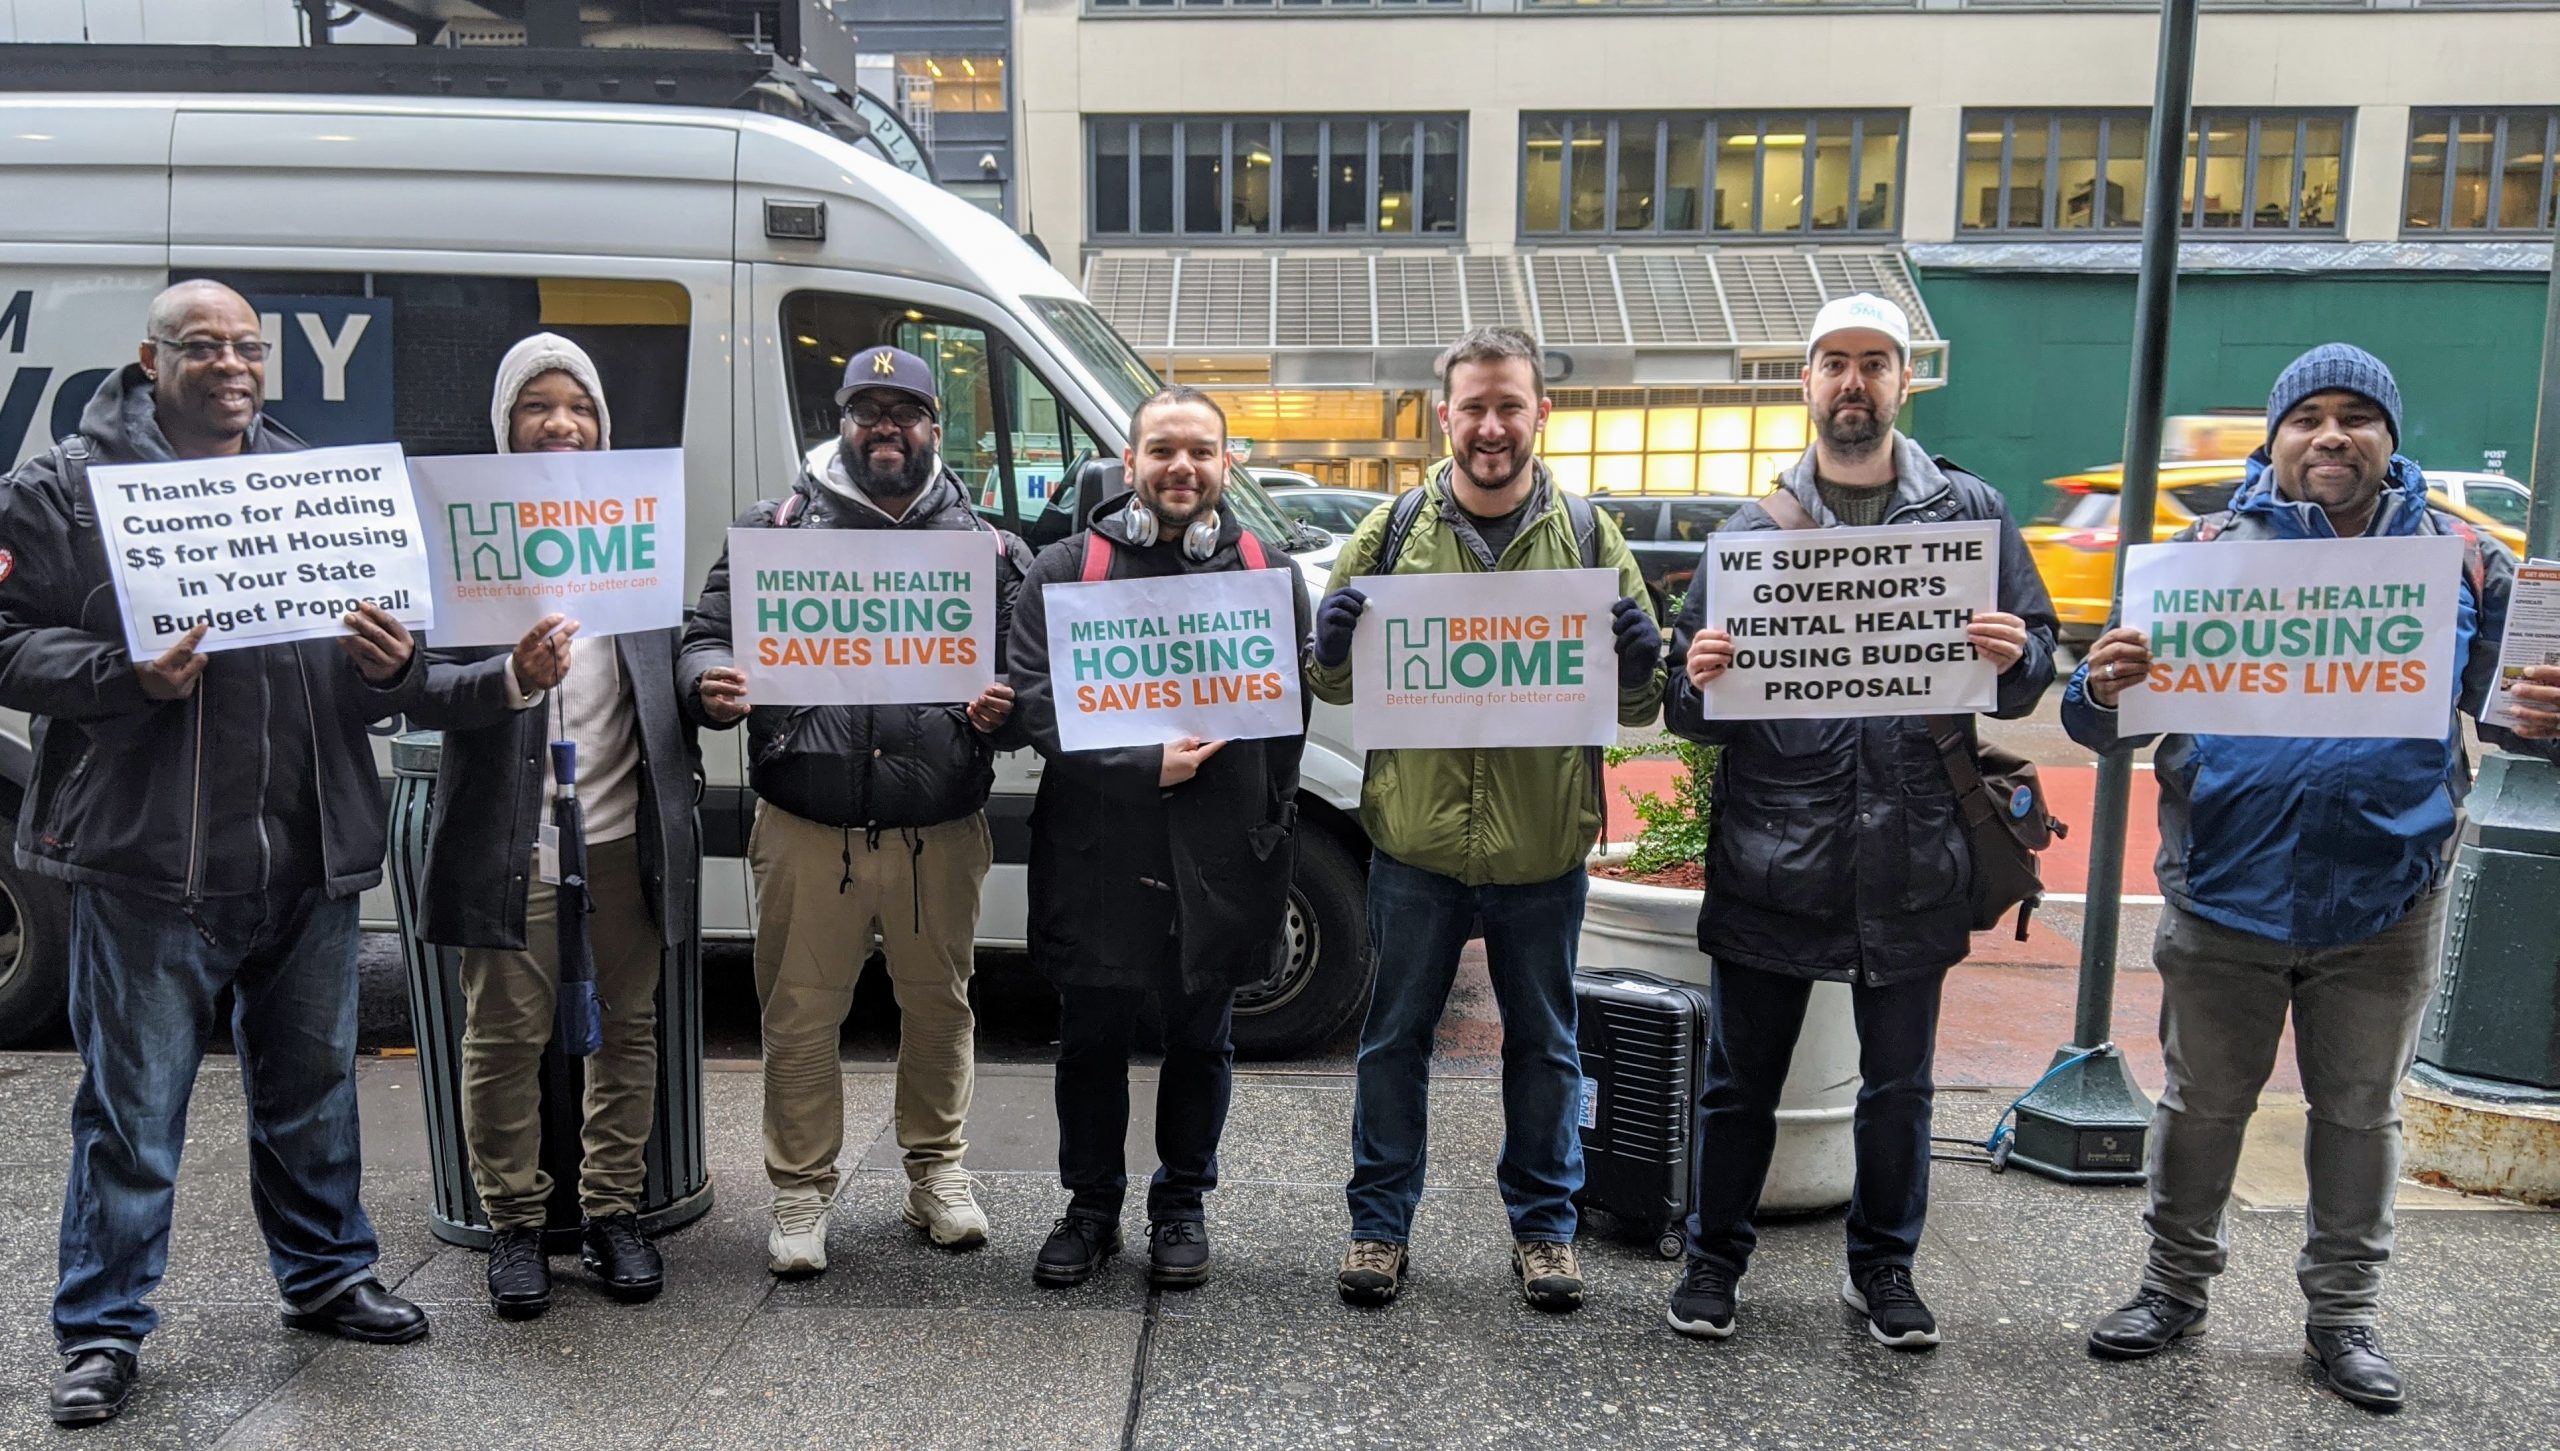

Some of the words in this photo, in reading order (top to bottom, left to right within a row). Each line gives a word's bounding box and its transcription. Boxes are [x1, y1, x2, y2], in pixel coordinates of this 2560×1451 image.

[873, 351, 895, 374] NY
[2484, 450, 2507, 458] POST
[2488, 460, 2502, 468] NO
[118, 478, 237, 503] Thanks
[246, 466, 383, 491] Governor
[123, 512, 232, 535] Cuomo
[240, 505, 283, 525] for
[294, 495, 396, 519] Adding
[518, 499, 624, 529] BRING
[635, 497, 658, 524] IT
[126, 546, 165, 570] $$
[175, 544, 218, 564] for
[228, 535, 278, 558] MH
[288, 527, 408, 552] Housing
[448, 501, 656, 582] HOME
[1720, 551, 1762, 571] WE
[1772, 545, 1912, 570] SUPPORT
[1922, 541, 1983, 563] THE
[177, 577, 208, 597] in
[216, 569, 287, 593] Your
[296, 560, 377, 583] State
[457, 585, 503, 599] Better
[506, 583, 564, 601] funding
[567, 581, 587, 594] for
[590, 579, 628, 592] better
[631, 577, 658, 589] care
[756, 570, 864, 593] MENTAL
[873, 571, 971, 593] HEALTH
[1753, 576, 1947, 604] GOVERNOR’S
[2153, 588, 2284, 613] MENTAL
[2297, 583, 2425, 611] HEALTH
[152, 607, 267, 636] Budget
[757, 597, 973, 633] HOUSING
[1071, 616, 1170, 642] MENTAL
[1178, 608, 1271, 635] HEALTH
[1450, 615, 1550, 642] BRING
[1562, 614, 1588, 639] IT
[1726, 615, 1844, 637] MENTAL
[1855, 608, 1974, 633] HEALTH
[2151, 615, 2424, 658] HOUSING
[758, 637, 872, 667] SAVES
[884, 637, 977, 666] LIVES
[1072, 635, 1275, 681] HOUSING
[1386, 617, 1584, 690] HOME
[1765, 676, 1931, 701] PROPOSAL!
[2148, 661, 2288, 694] SAVES
[2304, 659, 2427, 694] LIVES
[1077, 680, 1182, 713] SAVES
[1192, 672, 1283, 706] LIVES
[1386, 693, 1429, 705] Better
[1432, 692, 1484, 707] funding
[1488, 691, 1506, 704] for
[1510, 691, 1552, 704] better
[1555, 691, 1586, 703] care
